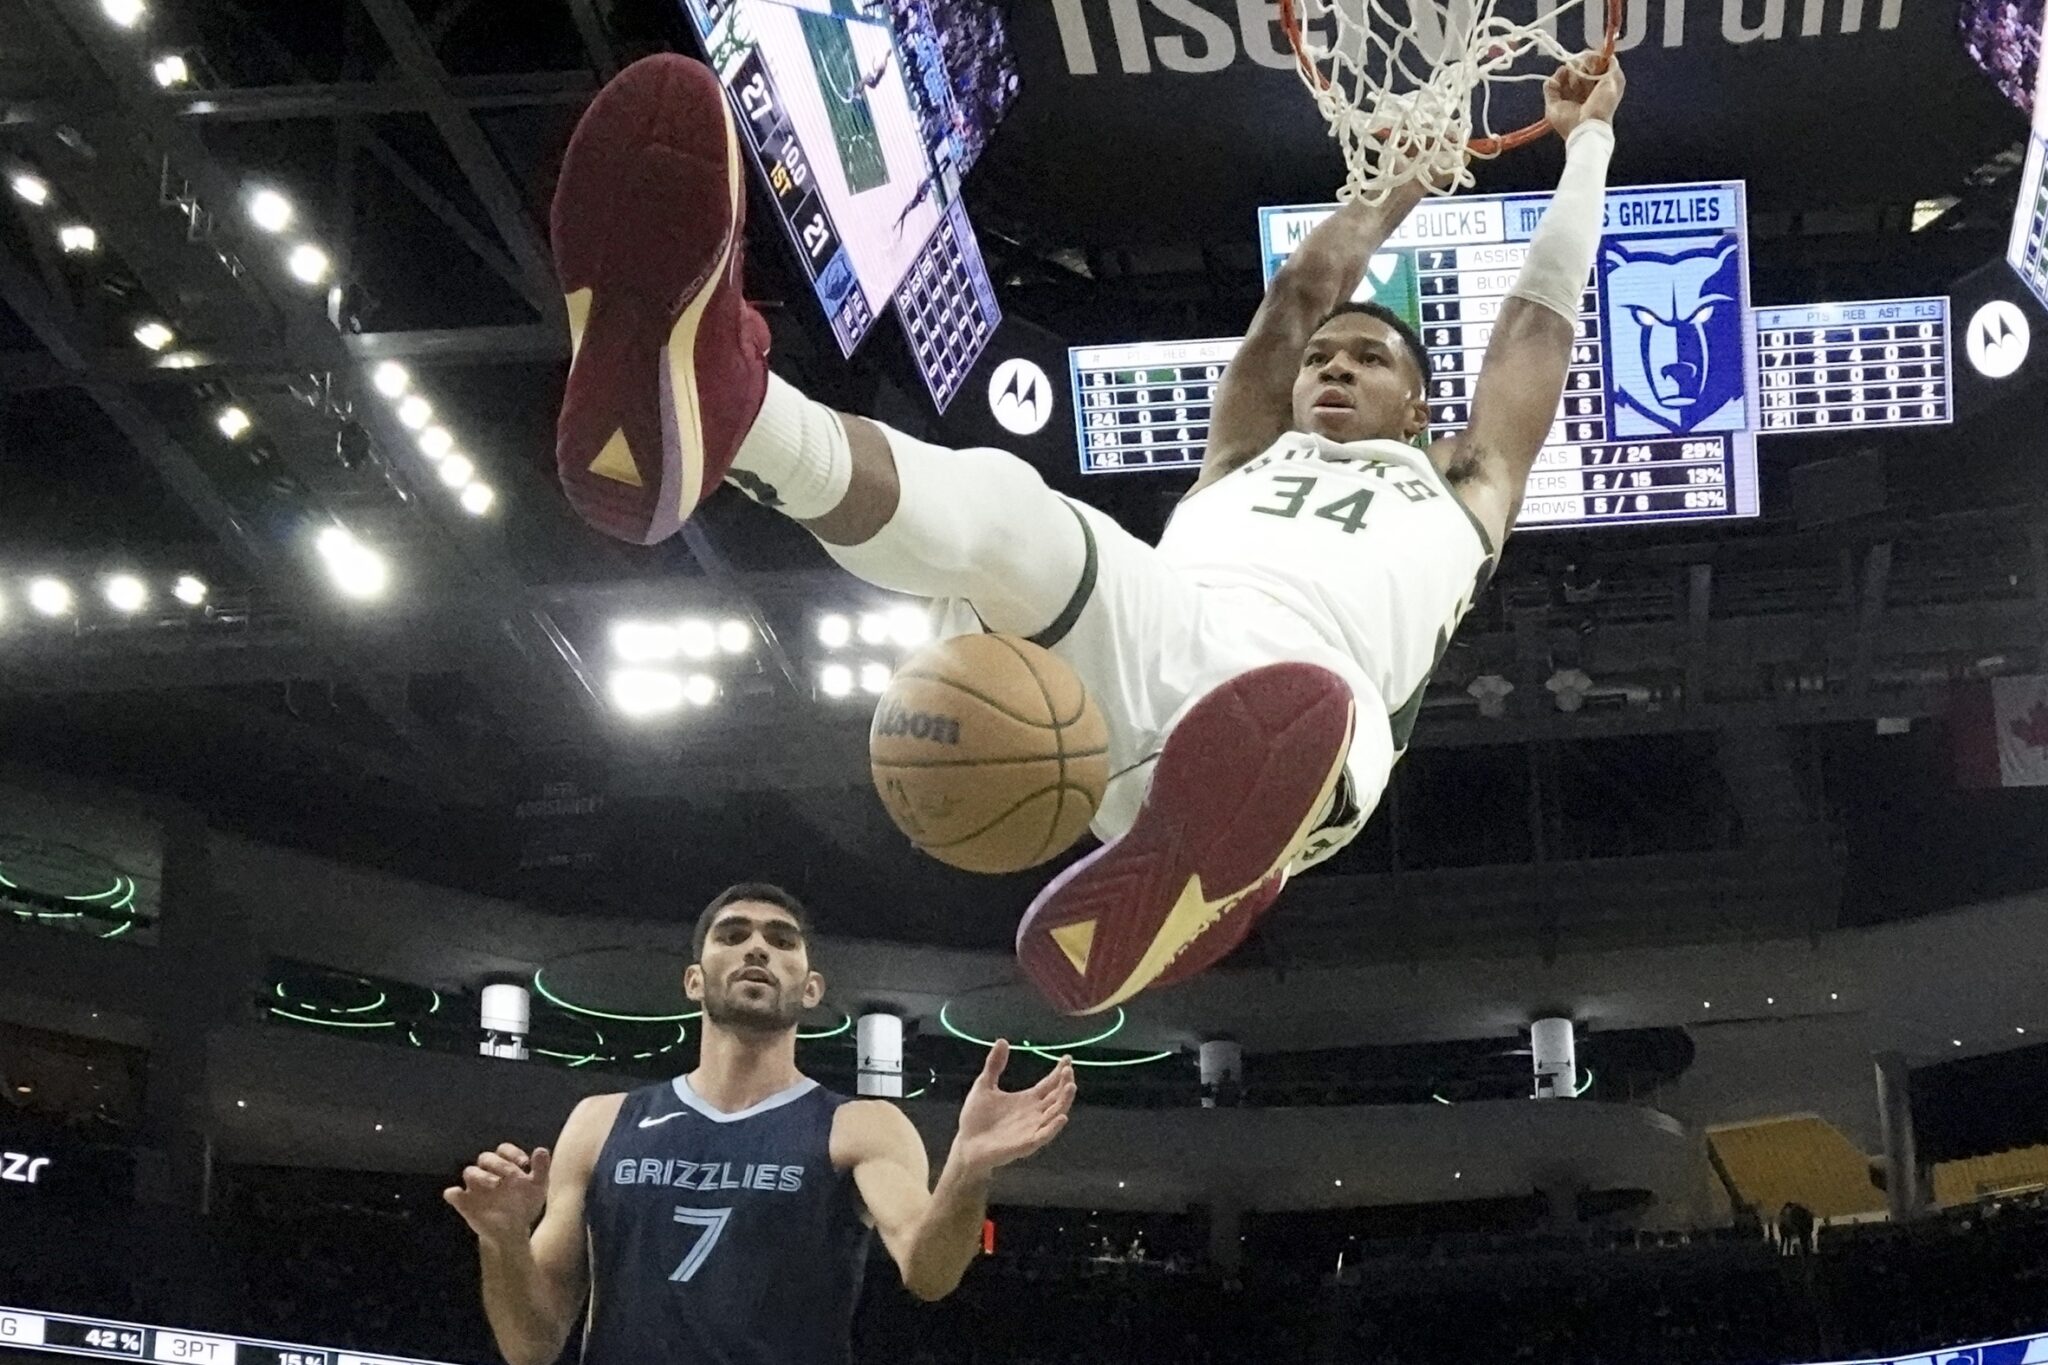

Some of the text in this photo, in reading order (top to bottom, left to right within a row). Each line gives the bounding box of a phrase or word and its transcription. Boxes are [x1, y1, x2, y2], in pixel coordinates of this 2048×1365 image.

[742, 73, 773, 121] 27
[782, 135, 807, 186] 10.0
[770, 160, 792, 198] 1ST
[1619, 197, 1720, 226] GRIZZLIES
[1416, 210, 1488, 237] BUCKS
[803, 213, 829, 257] 21
[1430, 249, 1528, 266] 7 ASSIST
[1434, 278, 1444, 293] 1
[1436, 304, 1446, 319] 1
[1843, 309, 1867, 321] REB
[1878, 307, 1901, 318] AST
[1914, 305, 1936, 317] FLS
[1435, 329, 1449, 345] 3
[1771, 324, 1933, 346] 0 2 1 1 0
[1432, 354, 1455, 370] 14
[1772, 352, 1785, 366] 7
[1849, 348, 1862, 362] 4
[1885, 346, 1899, 360] 0
[1923, 344, 1932, 358] 1
[1135, 370, 1147, 383] 0
[1173, 368, 1181, 382] 1
[1205, 366, 1219, 379] 0
[1814, 370, 1828, 384] 0
[1850, 368, 1864, 382] 0
[1886, 366, 1899, 380] 0
[1923, 364, 1932, 378] 1
[1439, 373, 1590, 397] 3 3
[1817, 390, 1826, 404] 1
[1889, 386, 1897, 400] 1
[1137, 390, 1149, 403] 0
[1173, 388, 1186, 401] 0
[1092, 412, 1115, 426] 24
[1138, 411, 1151, 424] 0
[1441, 406, 1455, 421] 4
[1816, 410, 1829, 424] 0
[1852, 408, 1865, 422] 0
[1887, 406, 1900, 420] 0
[1921, 404, 1935, 418] 0
[1093, 432, 1117, 446] 34
[1096, 452, 1120, 467] 42
[1591, 449, 1603, 465] 7
[1627, 446, 1652, 462] 24
[1593, 474, 1606, 490] 2
[1630, 471, 1652, 488] 15
[1686, 466, 1723, 484] 13%
[1251, 475, 1375, 534] 34
[1521, 500, 1577, 516] HROWS
[0, 1151, 50, 1183] zr
[614, 1158, 804, 1192] GRIZZLIES
[668, 1205, 733, 1282] 7
[173, 1338, 220, 1360] 3PT
